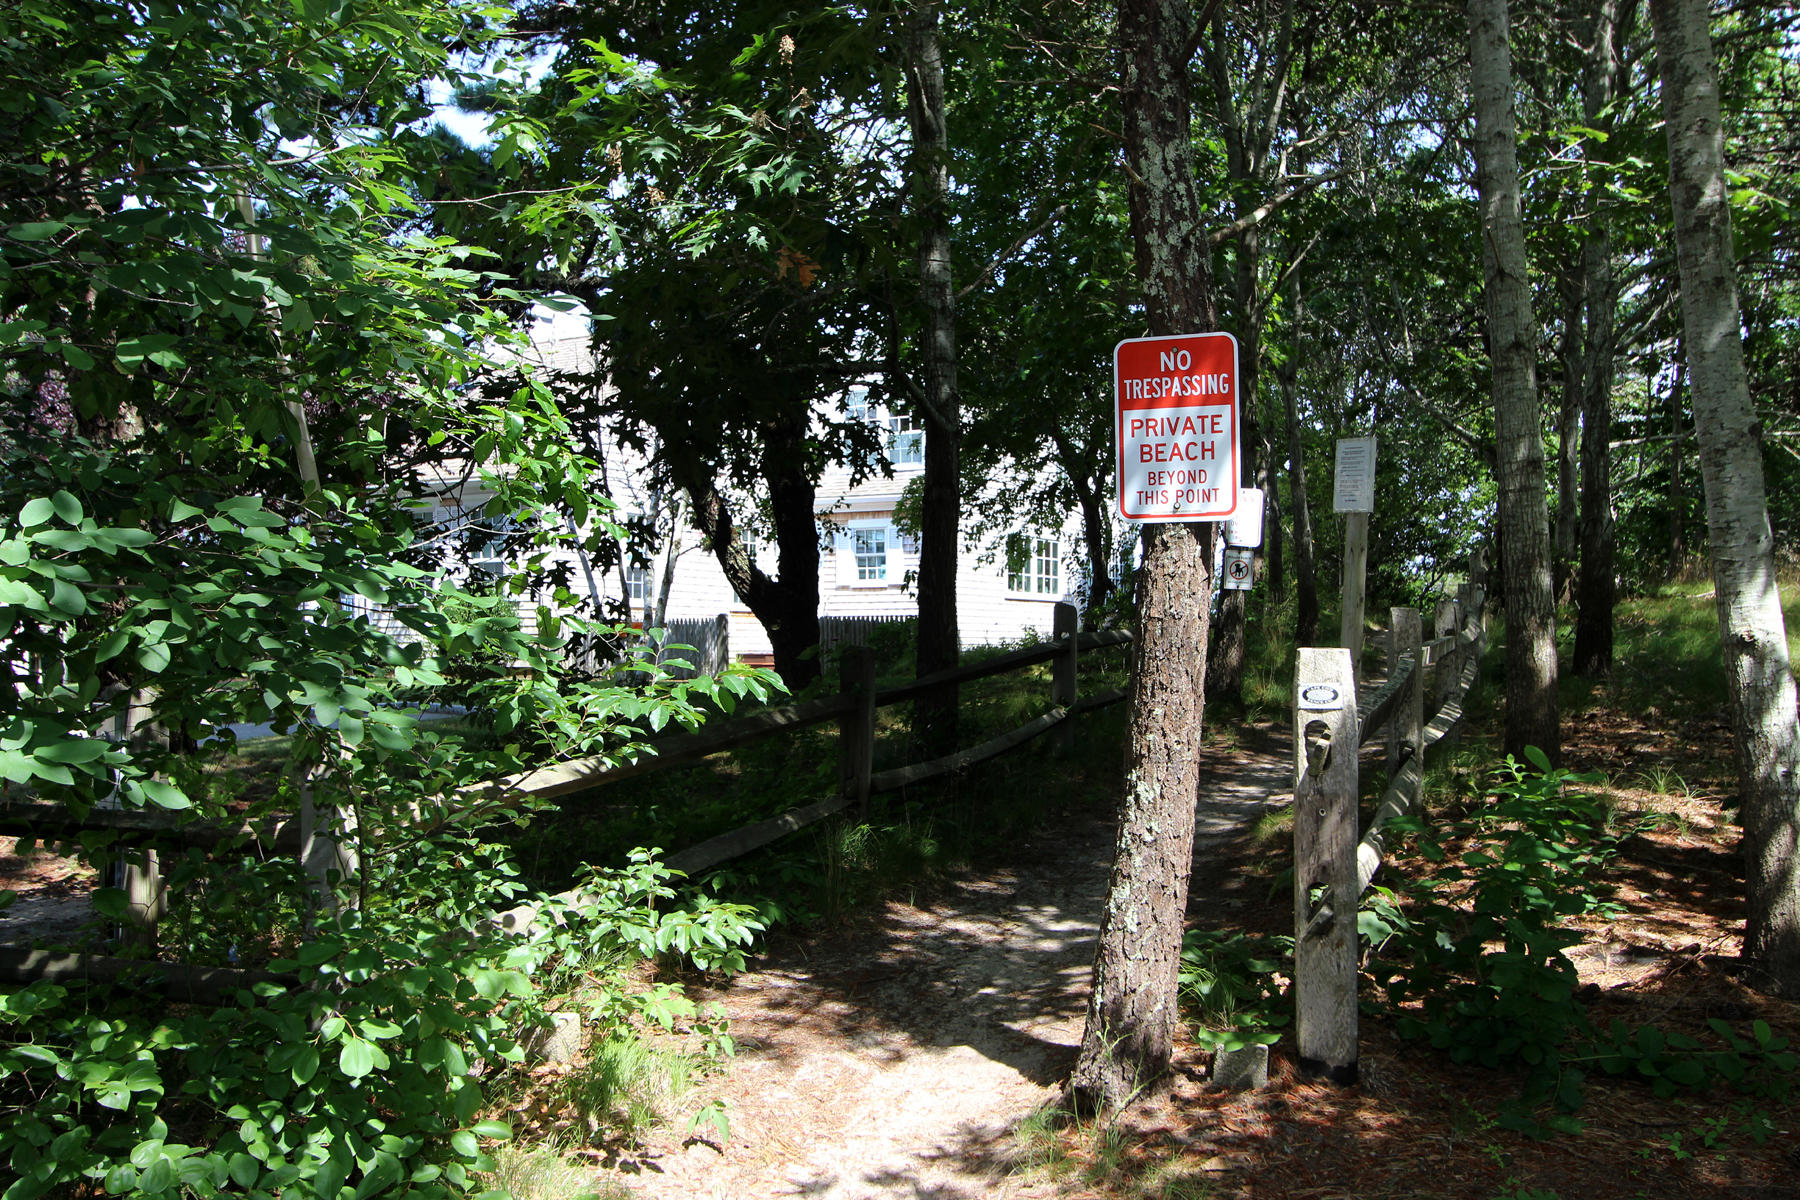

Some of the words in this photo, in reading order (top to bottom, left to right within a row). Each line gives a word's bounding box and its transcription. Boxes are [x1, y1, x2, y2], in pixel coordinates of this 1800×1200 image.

[1160, 350, 1192, 372] NO
[1124, 373, 1229, 400] TRESPASSING
[1131, 414, 1224, 438] PRIVATE
[1140, 440, 1215, 463] BEACH
[1148, 469, 1208, 486] BEYOND
[1137, 490, 1169, 506] THIS
[1175, 488, 1219, 504] POINT
